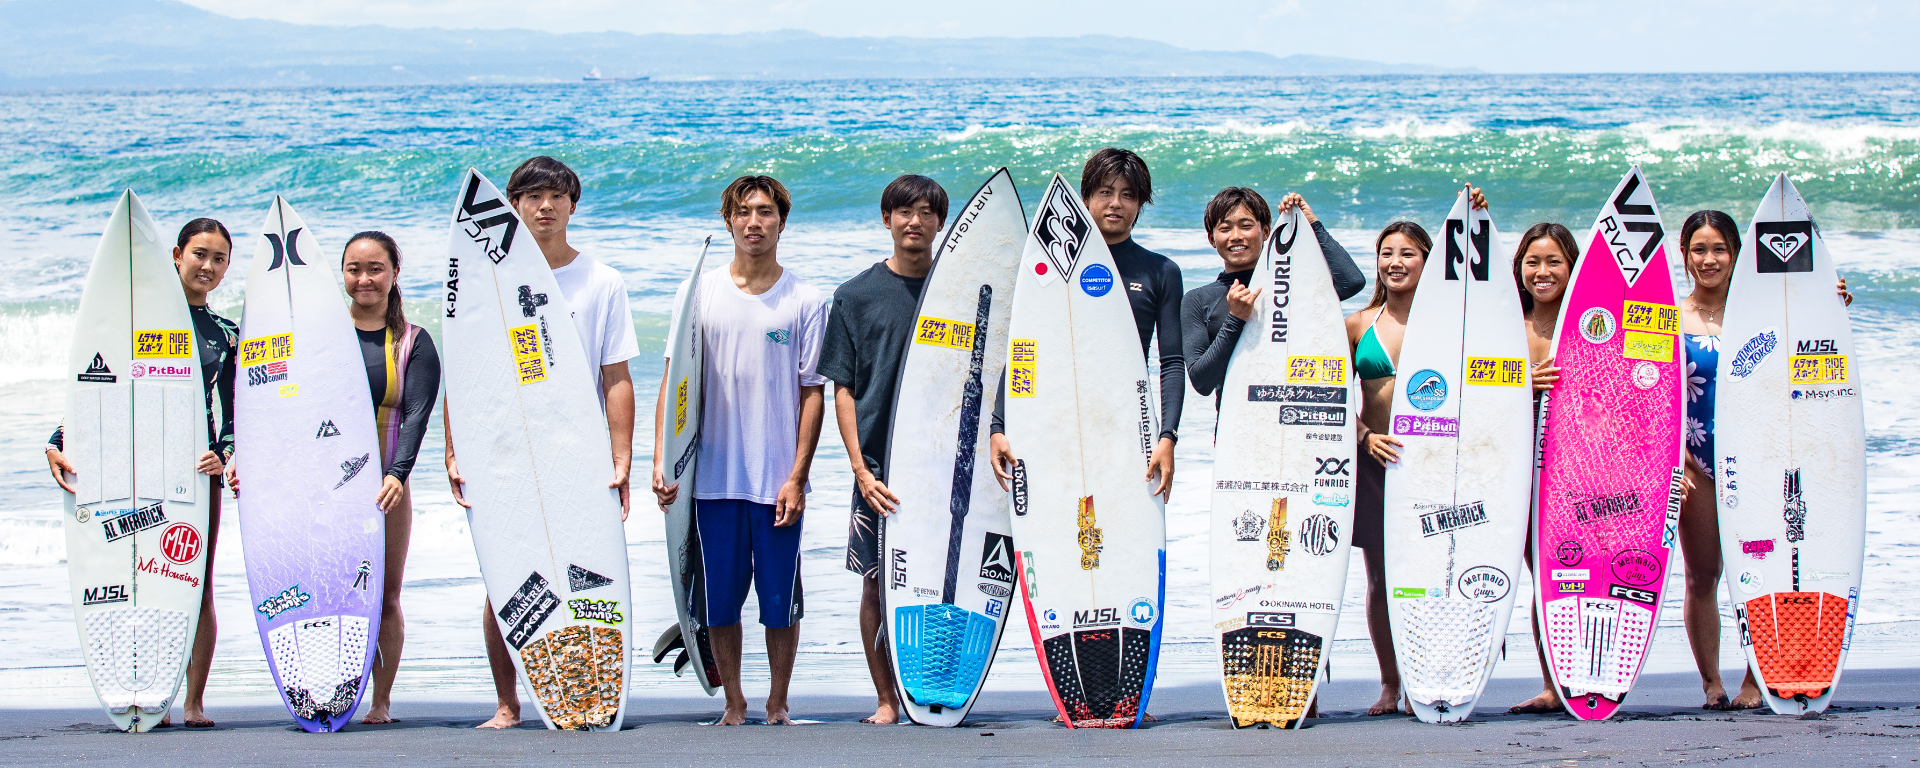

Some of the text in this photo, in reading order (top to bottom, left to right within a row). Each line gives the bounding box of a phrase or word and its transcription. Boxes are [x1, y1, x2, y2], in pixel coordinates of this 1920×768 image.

[946, 186, 993, 252] AIRTIGHT
[456, 207, 506, 265] RVCA
[1600, 215, 1640, 283] RVCA
[446, 258, 459, 318] K-DASH
[1627, 304, 1653, 315] ムラサキ
[1659, 308, 1678, 321] RIDE
[922, 319, 948, 331] ムラサキ
[1626, 314, 1652, 325] スポーツ
[1658, 319, 1677, 332] LIFE
[920, 330, 946, 341] スポーツ
[952, 324, 972, 337] RIDE
[138, 333, 163, 342] ムラサキ
[169, 333, 188, 343] RIDE
[272, 335, 290, 348] RIDE
[951, 335, 971, 348] LIFE
[138, 343, 163, 352] スポーツ
[169, 344, 188, 354] LIFE
[243, 340, 266, 352] ムラサキ
[272, 346, 292, 359] LIFE
[1012, 342, 1024, 362] RIDE
[1024, 341, 1035, 362] LIFE
[1732, 332, 1765, 373] SHIMIZU
[1797, 340, 1838, 352] MJSL
[244, 348, 267, 362] スポーツ
[530, 358, 545, 380] RIDE
[1322, 359, 1344, 371] RIDE
[1470, 360, 1496, 369] ムラサキ
[1502, 360, 1523, 372] RIDE
[1793, 359, 1818, 368] ムラサキ
[1825, 358, 1845, 368] RIDE
[148, 366, 191, 375] PitBull
[248, 364, 268, 387] SSS
[520, 360, 534, 382] LIFE
[1322, 370, 1343, 382] LIFE
[1470, 370, 1496, 379] スポーツ
[1794, 369, 1819, 378] スポーツ
[1825, 369, 1845, 380] LIFE
[1012, 368, 1021, 394] ムラサキ
[1021, 368, 1031, 394] スポーツ
[1502, 372, 1522, 384] LIFE
[1299, 411, 1345, 421] PitBull
[1537, 393, 1553, 472] AIRTIGHT
[1725, 456, 1738, 490] あずま
[1314, 478, 1349, 488] FUNRIDE
[1666, 468, 1684, 521] FUNRIDE
[1420, 503, 1487, 535] AL MERRICK
[1576, 503, 1589, 523] AL
[103, 504, 167, 540] AL MERRICK
[160, 562, 200, 588] Housing
[894, 548, 907, 590] MJSL
[981, 568, 1012, 582] ROAM
[1024, 551, 1038, 599] FCS
[1626, 571, 1648, 582] Guys
[1559, 582, 1585, 590] ハットリ
[84, 585, 128, 602] MJSL
[1474, 588, 1497, 599] Guys
[1612, 586, 1654, 603] FCS
[1270, 600, 1336, 610] OKINAWA HOTEL
[1586, 602, 1615, 611] FCS
[1784, 597, 1813, 605] FCS
[512, 597, 556, 646] DAKINE
[1073, 608, 1121, 624] MJSL
[1250, 614, 1293, 626] FCS
[303, 620, 331, 630] FCS
[1214, 616, 1246, 630] CRYSTAL
[1221, 623, 1242, 632] AUTO
[1735, 603, 1752, 646] FCS
[1257, 631, 1287, 639] FCS
